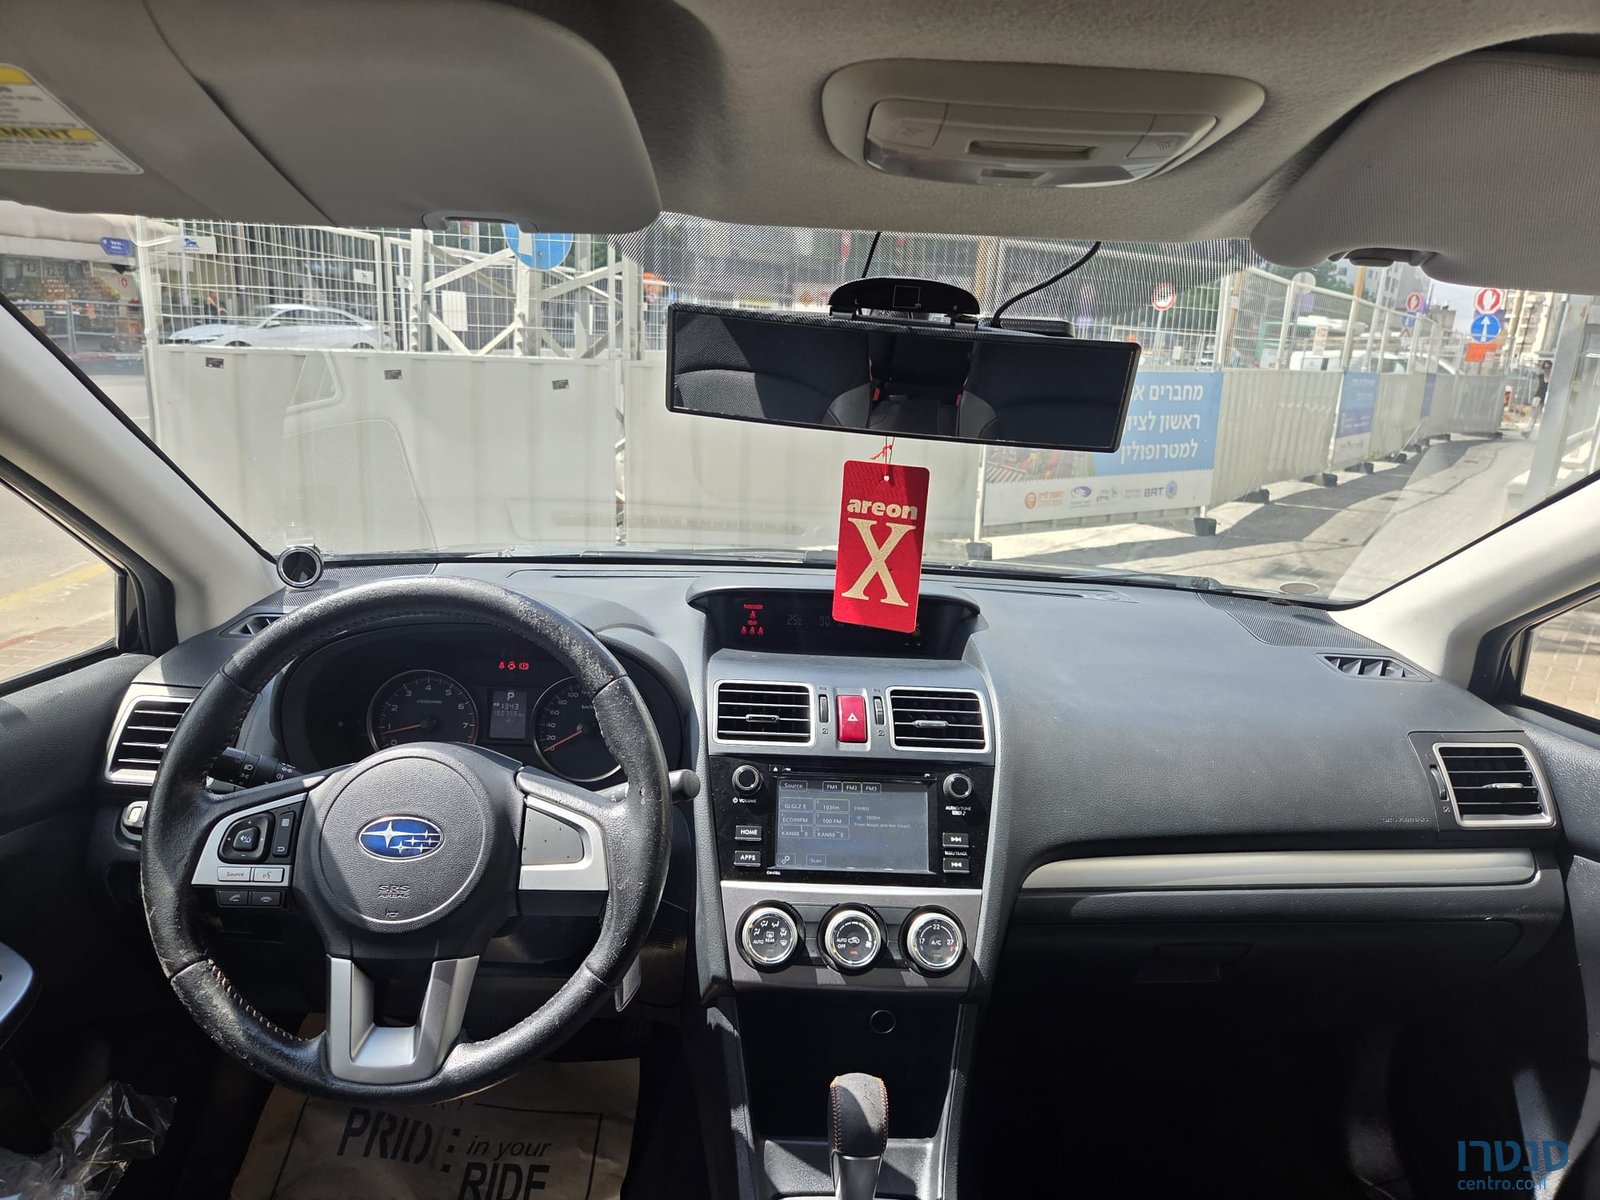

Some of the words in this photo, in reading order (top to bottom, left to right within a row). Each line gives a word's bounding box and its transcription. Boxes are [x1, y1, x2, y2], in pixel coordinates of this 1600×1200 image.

[0, 127, 73, 139] MENT
[1133, 385, 1145, 401] א
[1149, 384, 1203, 400] מחברים
[1127, 410, 1156, 431] לציו
[1160, 414, 1200, 433] ראשון
[1121, 438, 1199, 464] למטרופולין
[847, 498, 918, 520] areon
[841, 517, 917, 607] X
[507, 692, 515, 700] P
[379, 885, 411, 893] SRS
[467, 1135, 490, 1156] in
[496, 1140, 552, 1161] your
